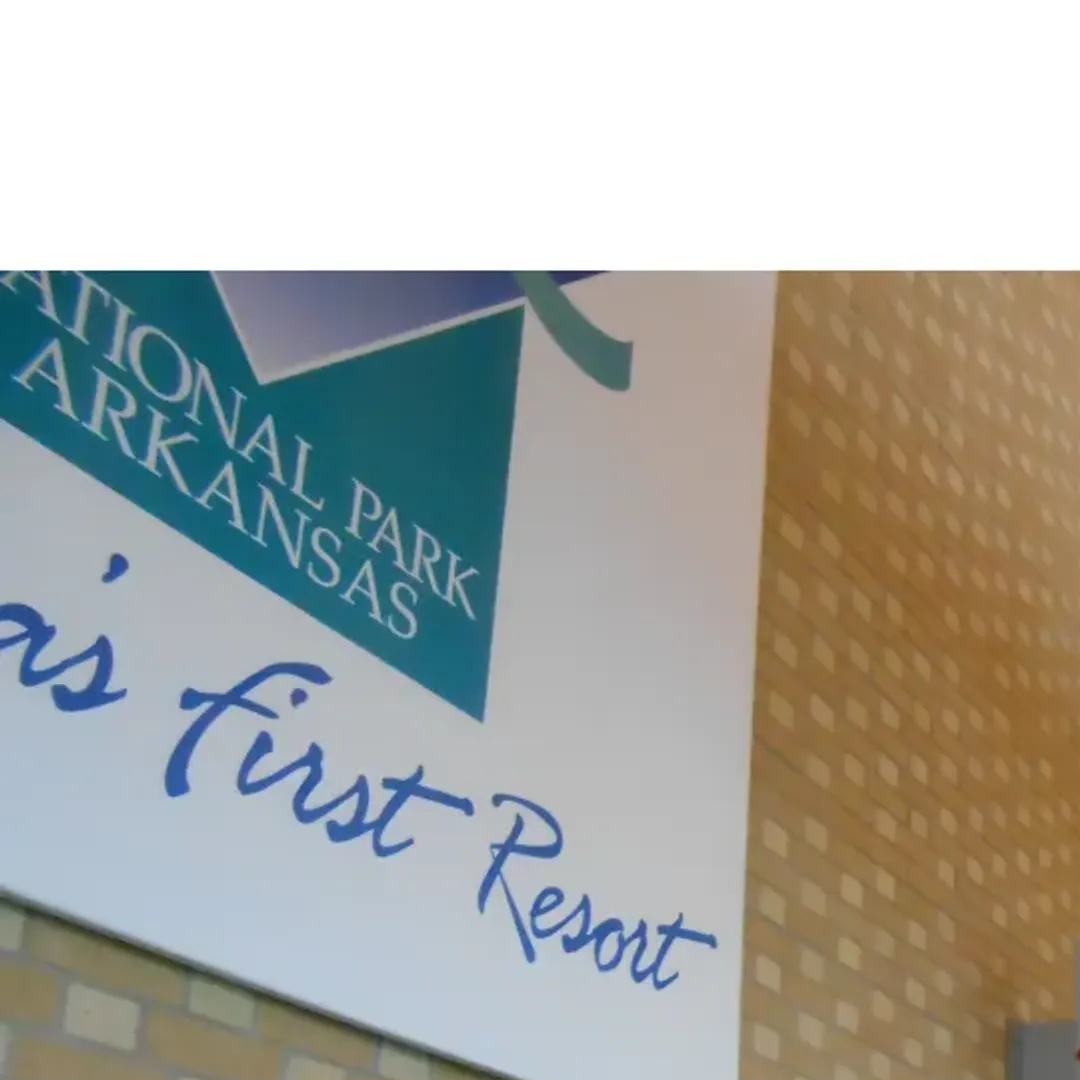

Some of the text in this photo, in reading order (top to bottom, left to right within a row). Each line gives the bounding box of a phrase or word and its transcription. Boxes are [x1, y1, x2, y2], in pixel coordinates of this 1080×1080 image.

[10, 337, 419, 640] ARKANSAS
[345, 476, 479, 621] PARK
[478, 793, 717, 990] Resort
